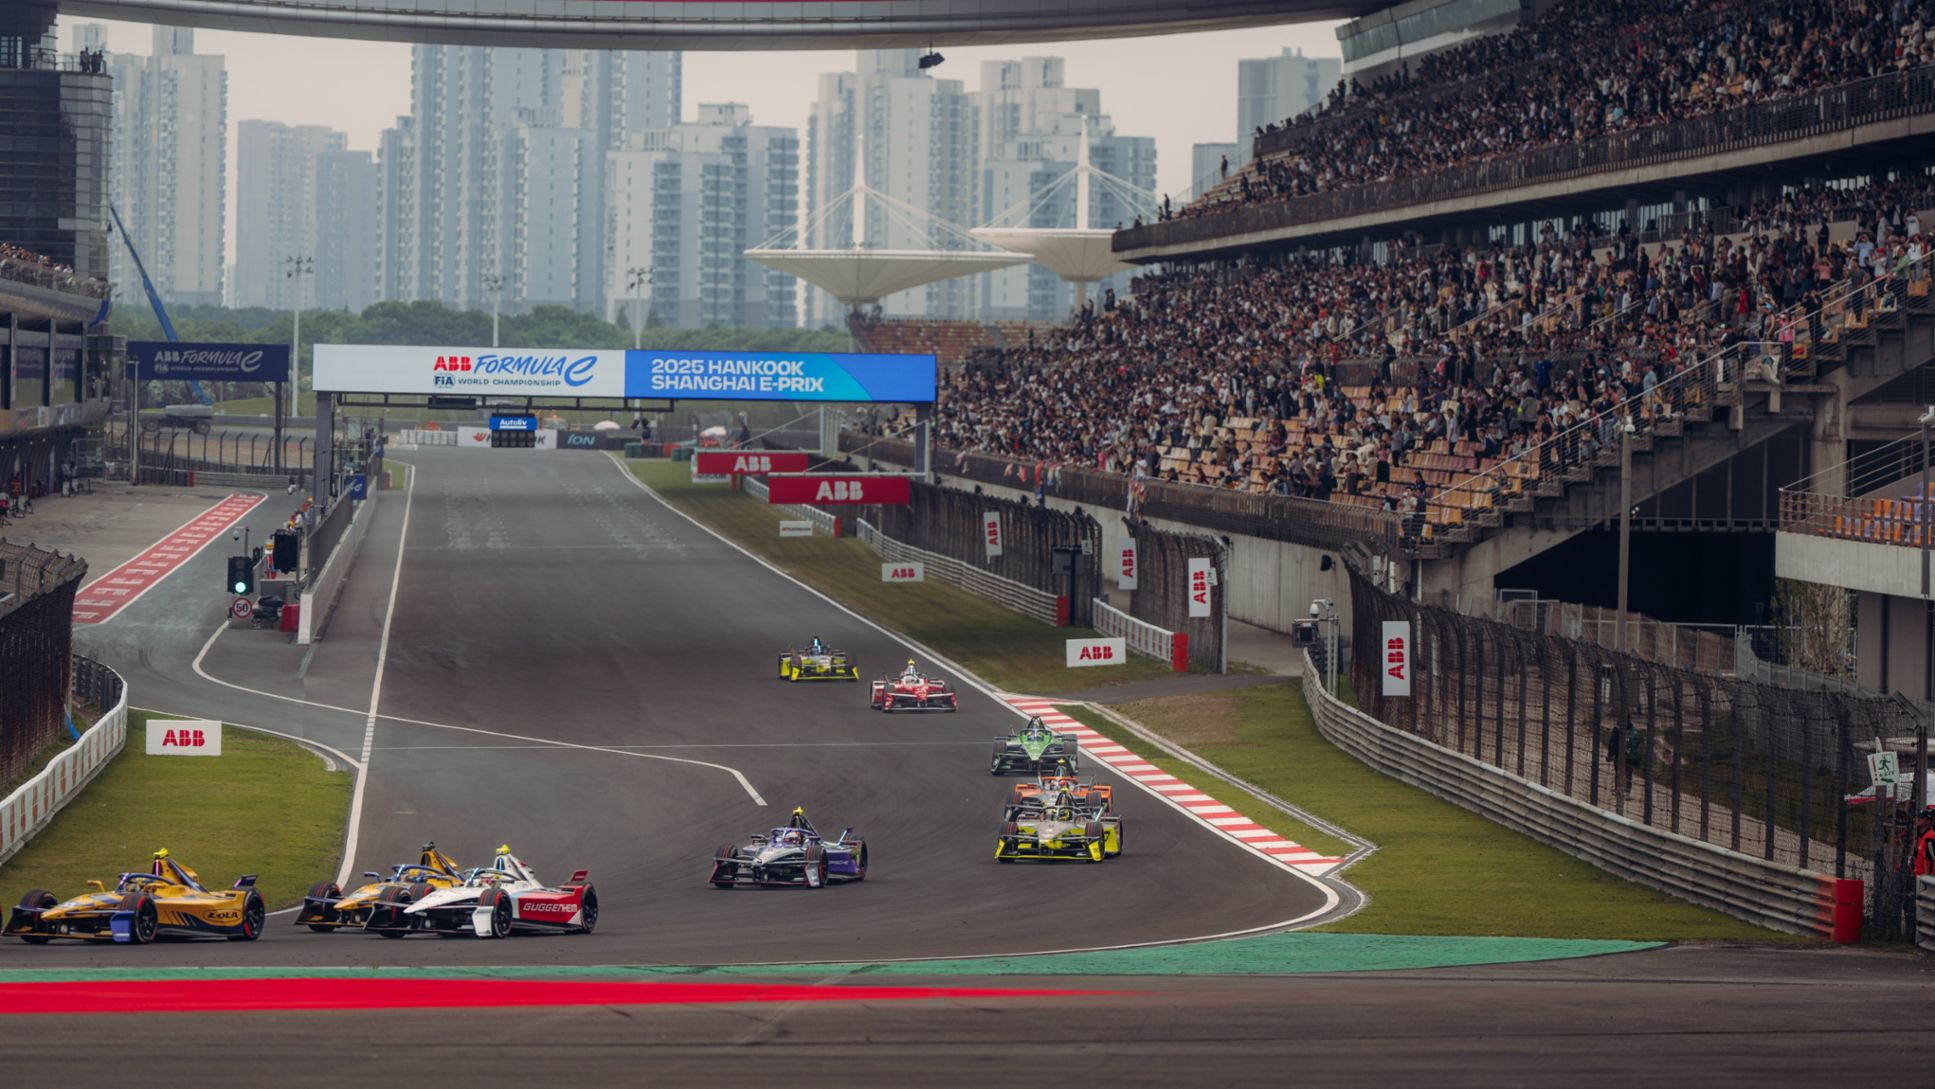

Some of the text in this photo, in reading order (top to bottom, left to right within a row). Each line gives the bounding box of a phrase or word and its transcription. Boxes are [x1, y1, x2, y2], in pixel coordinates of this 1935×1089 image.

[154, 351, 180, 362] ABB
[181, 350, 243, 364] FORMULA
[434, 355, 472, 372] ABB
[473, 354, 567, 375] FORMULA
[651, 358, 805, 376] 2025 HANKOOK
[457, 377, 489, 385] WORLD
[492, 378, 561, 387] CHAMPIONSHIP
[651, 374, 824, 392] SHANGHAI E-PRIX
[499, 418, 528, 426] Autoliv
[734, 456, 771, 472] ABB
[815, 481, 863, 501] ABB
[987, 521, 998, 546] ABB
[1122, 548, 1134, 578] ABB
[891, 568, 915, 578] ABB
[1193, 570, 1207, 605] ABB
[236, 603, 249, 613] 50
[1078, 645, 1114, 661] ABB
[1387, 637, 1405, 681] ABB
[162, 728, 206, 748] ABB
